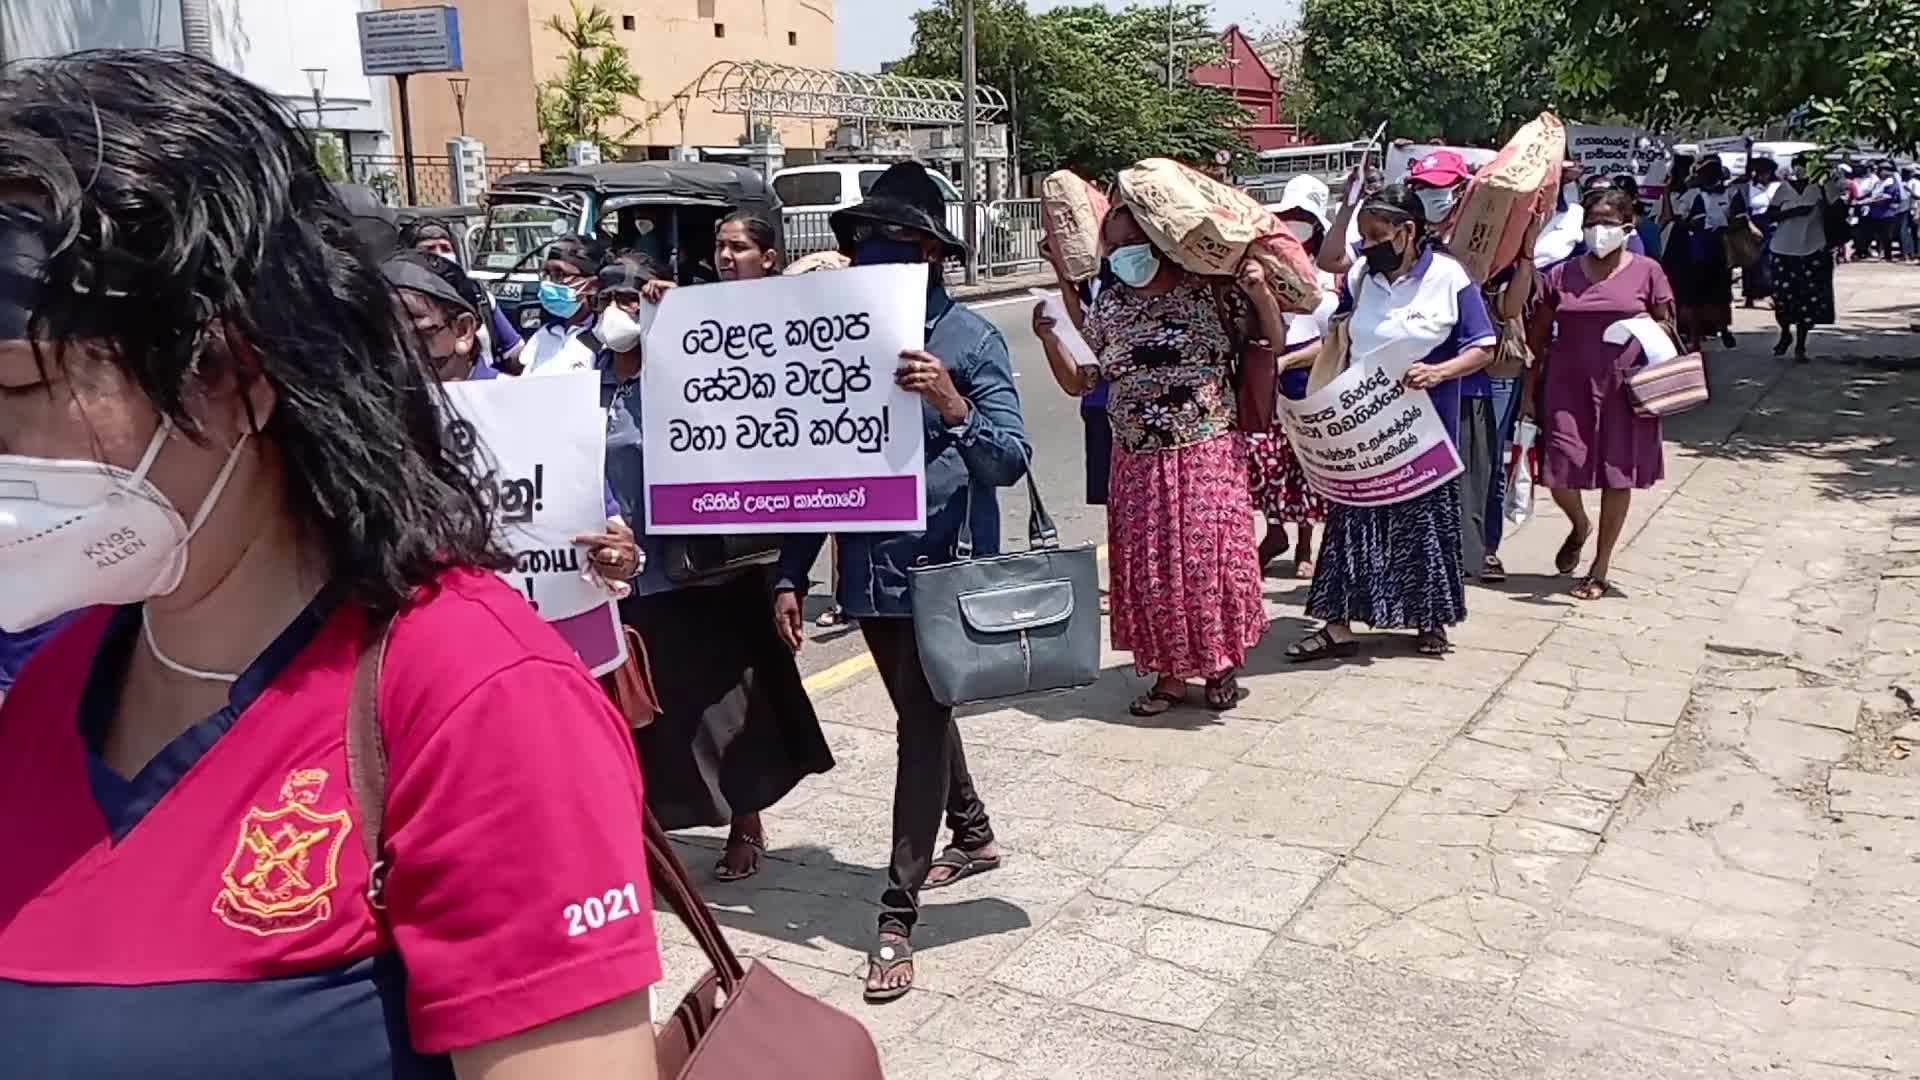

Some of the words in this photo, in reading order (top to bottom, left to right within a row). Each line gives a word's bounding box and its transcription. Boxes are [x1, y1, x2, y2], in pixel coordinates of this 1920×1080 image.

[683, 320, 777, 359] වෙළඳ
[785, 312, 869, 350] කලාප
[684, 366, 775, 403] සේවක
[786, 356, 871, 403] වැටුප්
[669, 419, 725, 452] වහා
[736, 408, 799, 449] වැඩි
[809, 406, 889, 453] කරනු!
[83, 525, 137, 560] KN95
[96, 539, 147, 570] ALLEN
[563, 882, 640, 937] 2021
